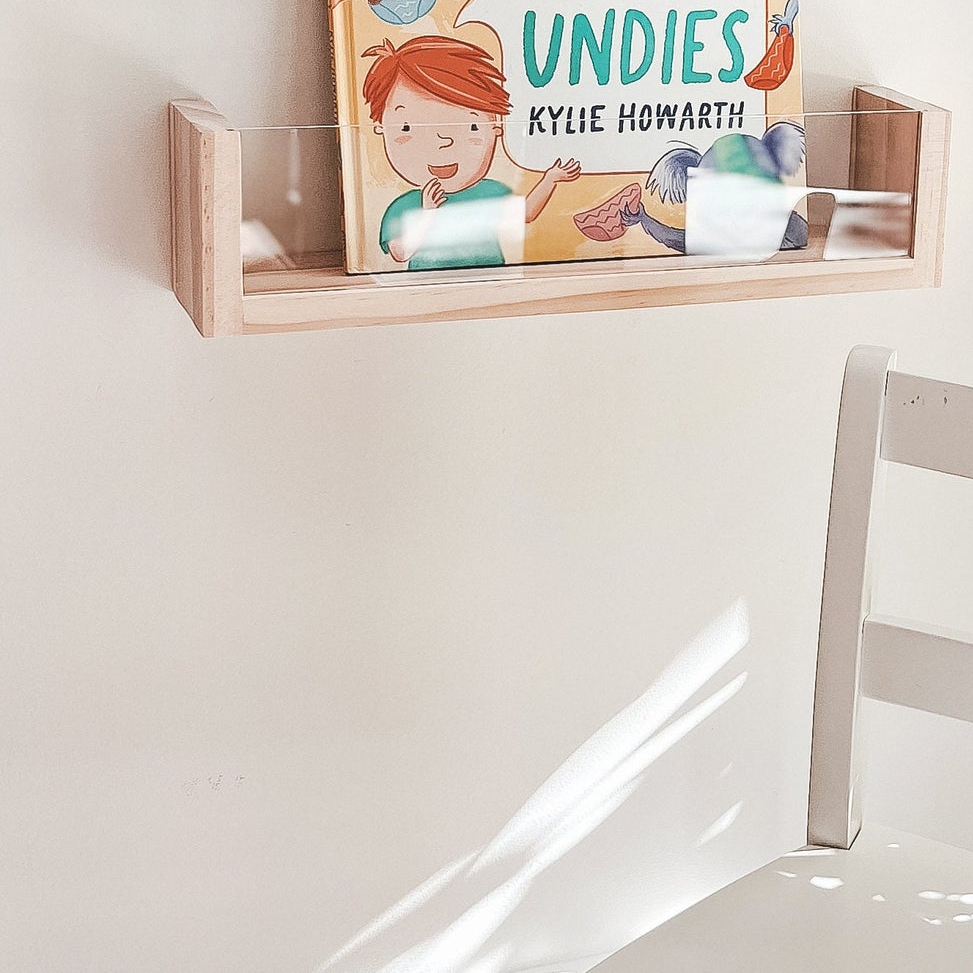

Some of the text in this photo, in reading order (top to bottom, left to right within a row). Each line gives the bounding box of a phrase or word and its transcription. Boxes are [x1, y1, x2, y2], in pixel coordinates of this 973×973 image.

[521, 8, 750, 88] UNDIES
[528, 100, 746, 136] KYLIE HOWARTH
